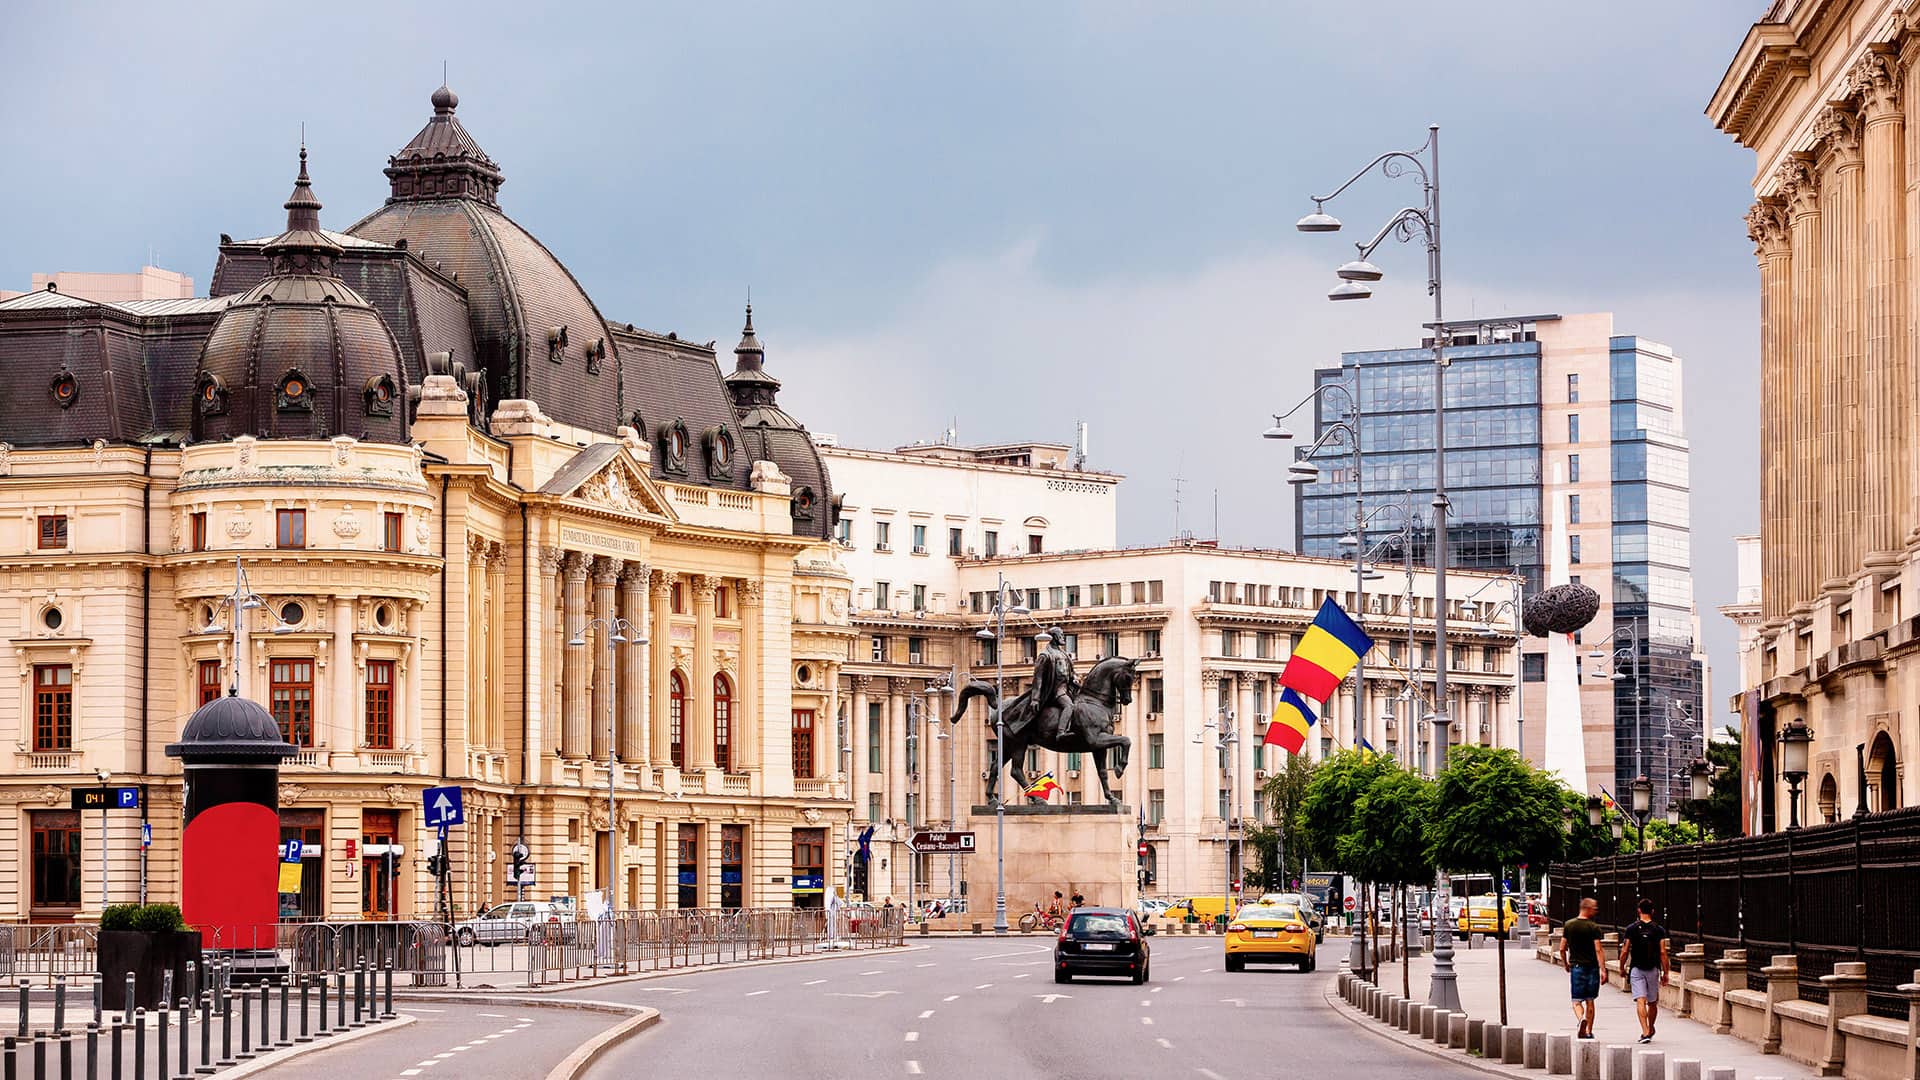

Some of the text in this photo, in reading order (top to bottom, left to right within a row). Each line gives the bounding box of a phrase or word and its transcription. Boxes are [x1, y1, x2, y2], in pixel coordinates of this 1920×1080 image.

[122, 792, 133, 804] P
[929, 833, 947, 841] Palatul
[288, 841, 299, 859] P
